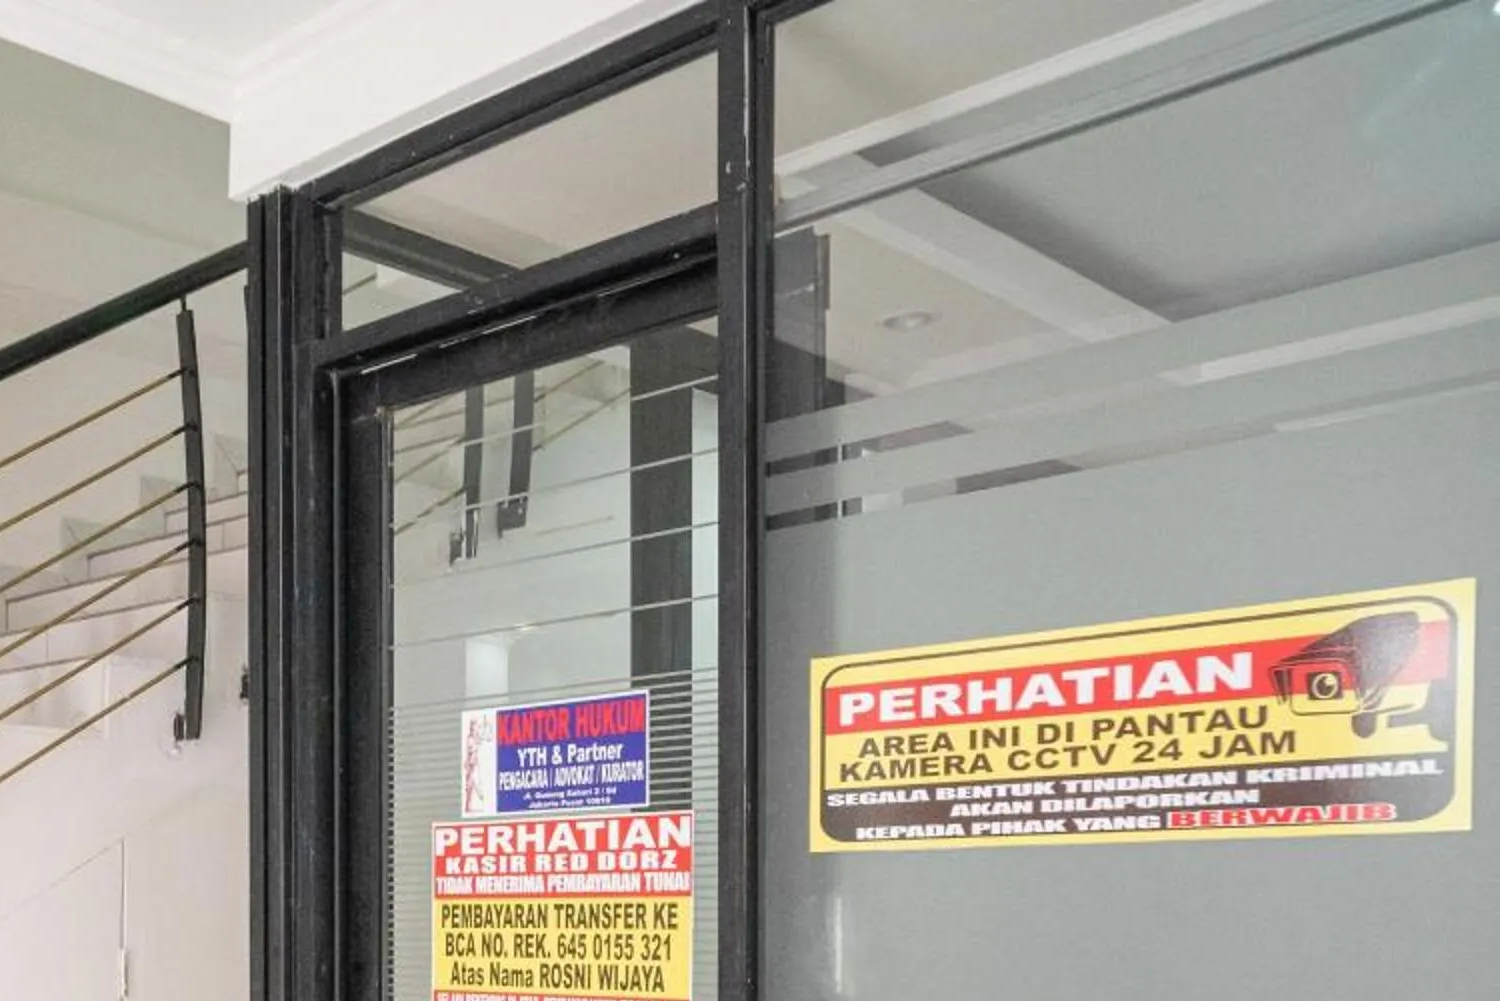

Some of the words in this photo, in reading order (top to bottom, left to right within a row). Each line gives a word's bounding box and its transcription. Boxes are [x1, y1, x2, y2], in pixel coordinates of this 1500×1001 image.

[838, 651, 1254, 727] PERHATIAN
[498, 708, 570, 745] KANTOR
[575, 697, 645, 737] HUKUM
[858, 731, 955, 759] AREA
[968, 725, 1020, 751] INI
[1036, 720, 1074, 745] DI
[1091, 704, 1268, 741] PANTAU
[516, 747, 547, 768] YTH
[551, 746, 564, 765] &
[567, 742, 623, 763] Partner
[839, 753, 993, 783] KAMERA
[1007, 743, 1117, 771] CCTV
[1132, 737, 1183, 764] 24
[1198, 729, 1297, 759] JAM
[499, 767, 549, 791] PENGACARA
[553, 763, 595, 787] ADVOKAT
[601, 759, 645, 782] KURATOR
[826, 788, 930, 807] SEGALA
[934, 780, 1060, 802] BENTUK
[1060, 769, 1238, 794] TINDAKAN
[1245, 758, 1445, 784] KRIMINAL
[949, 799, 1035, 819] AKAN
[1038, 788, 1261, 815] DILAPORKAN
[435, 816, 690, 857] PERHATIAN
[854, 823, 967, 841] KEPADA
[971, 818, 1069, 837] PIHAK
[1073, 814, 1161, 834] YANG
[1167, 802, 1397, 829] BERWAJIB
[445, 854, 527, 875] KASIR
[535, 852, 589, 873] RED
[597, 849, 678, 871] DORZ
[436, 875, 473, 895] TIDAK
[475, 874, 546, 894] MENERIMA
[549, 872, 641, 893] PEMBAYARAN
[644, 870, 690, 892] TUNAI
[441, 903, 549, 930] PEMBAYARAN
[553, 902, 648, 930] TRANSFER
[653, 902, 679, 930] KE
[444, 932, 477, 958] BCA
[481, 933, 508, 958] NO.
[513, 933, 551, 959] REK.
[557, 933, 588, 960] 645
[592, 933, 635, 961] 0155
[640, 933, 672, 961] 321
[450, 961, 485, 987] Atas
[489, 962, 535, 988] Nama
[539, 963, 592, 990] ROSNI
[598, 964, 666, 993] WIJAYA
